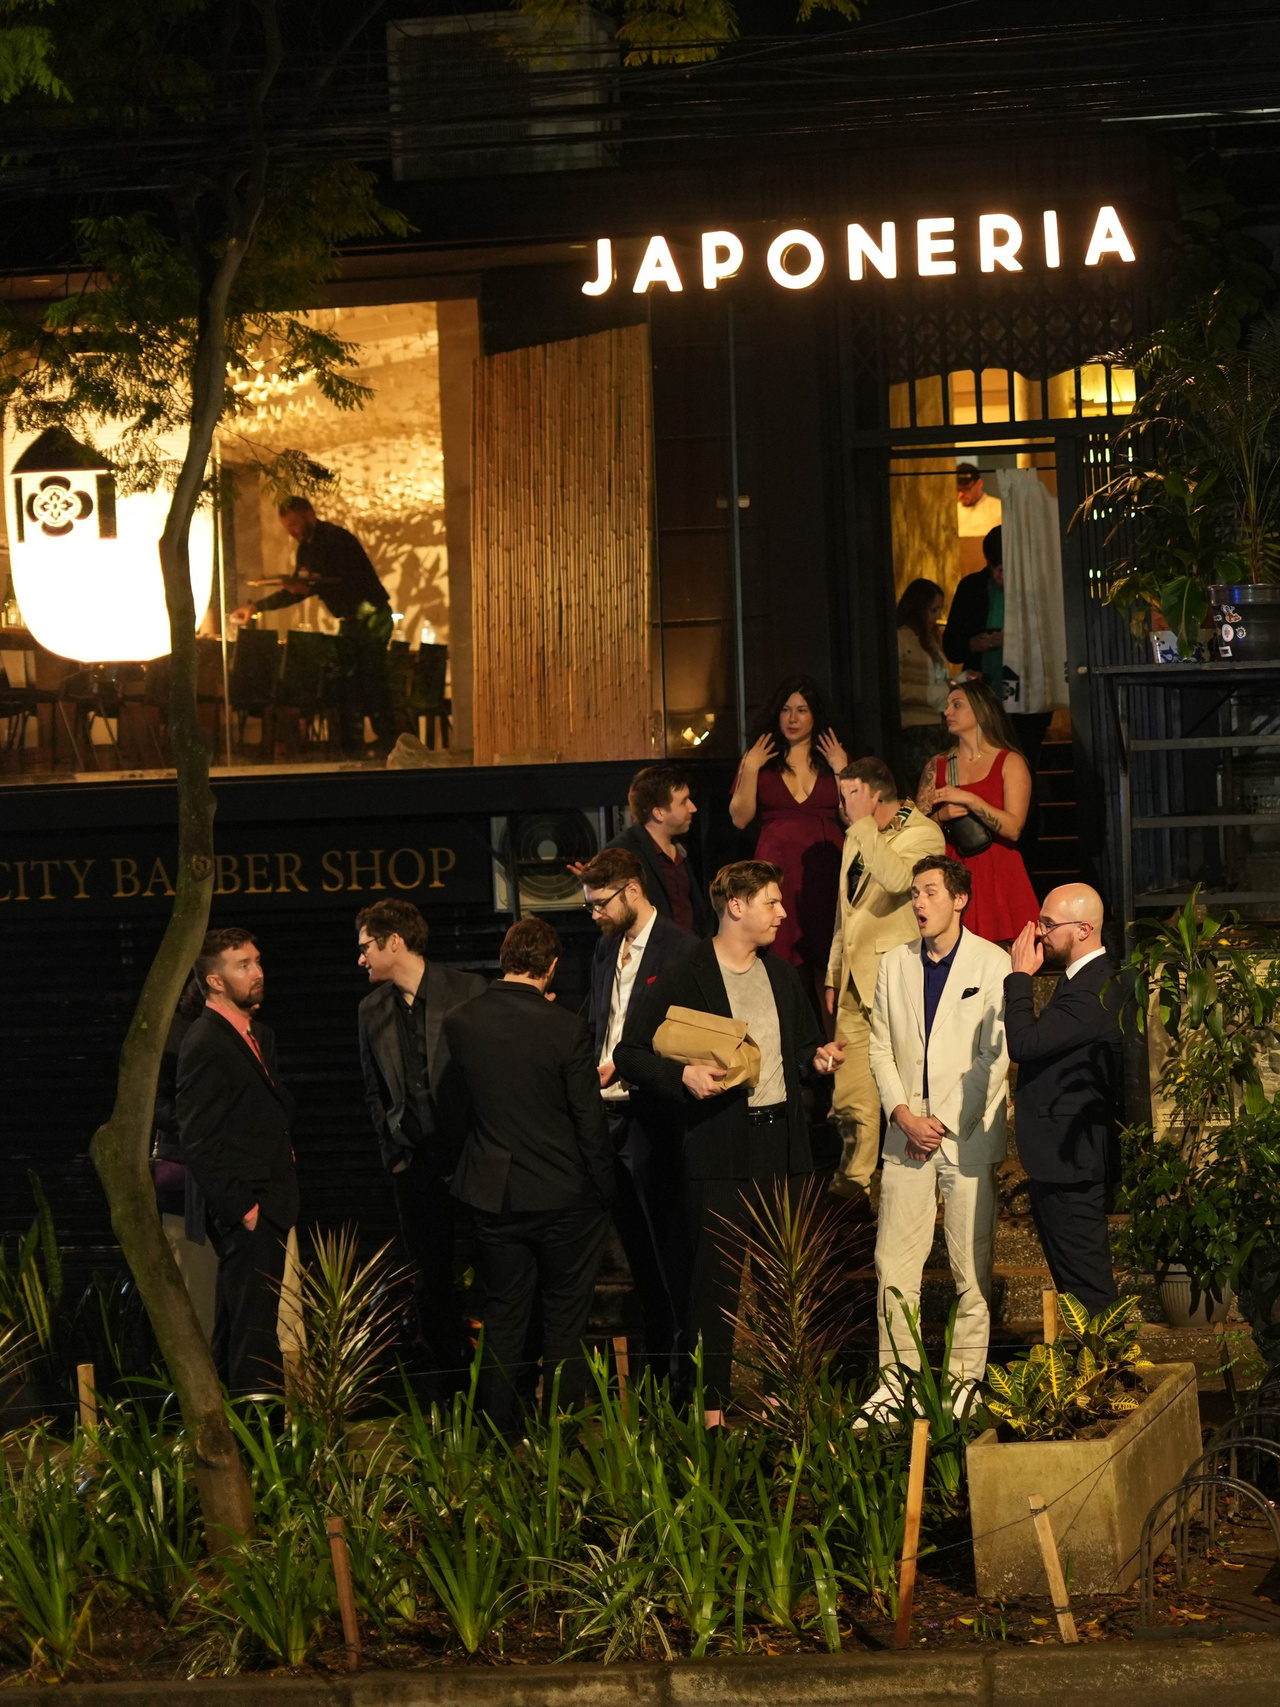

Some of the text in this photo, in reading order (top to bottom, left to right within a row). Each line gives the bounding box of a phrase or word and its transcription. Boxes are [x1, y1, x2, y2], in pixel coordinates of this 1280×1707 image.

[581, 206, 1136, 296] JAPONERIA
[111, 853, 310, 898] BABER
[321, 847, 456, 892] SHOP
